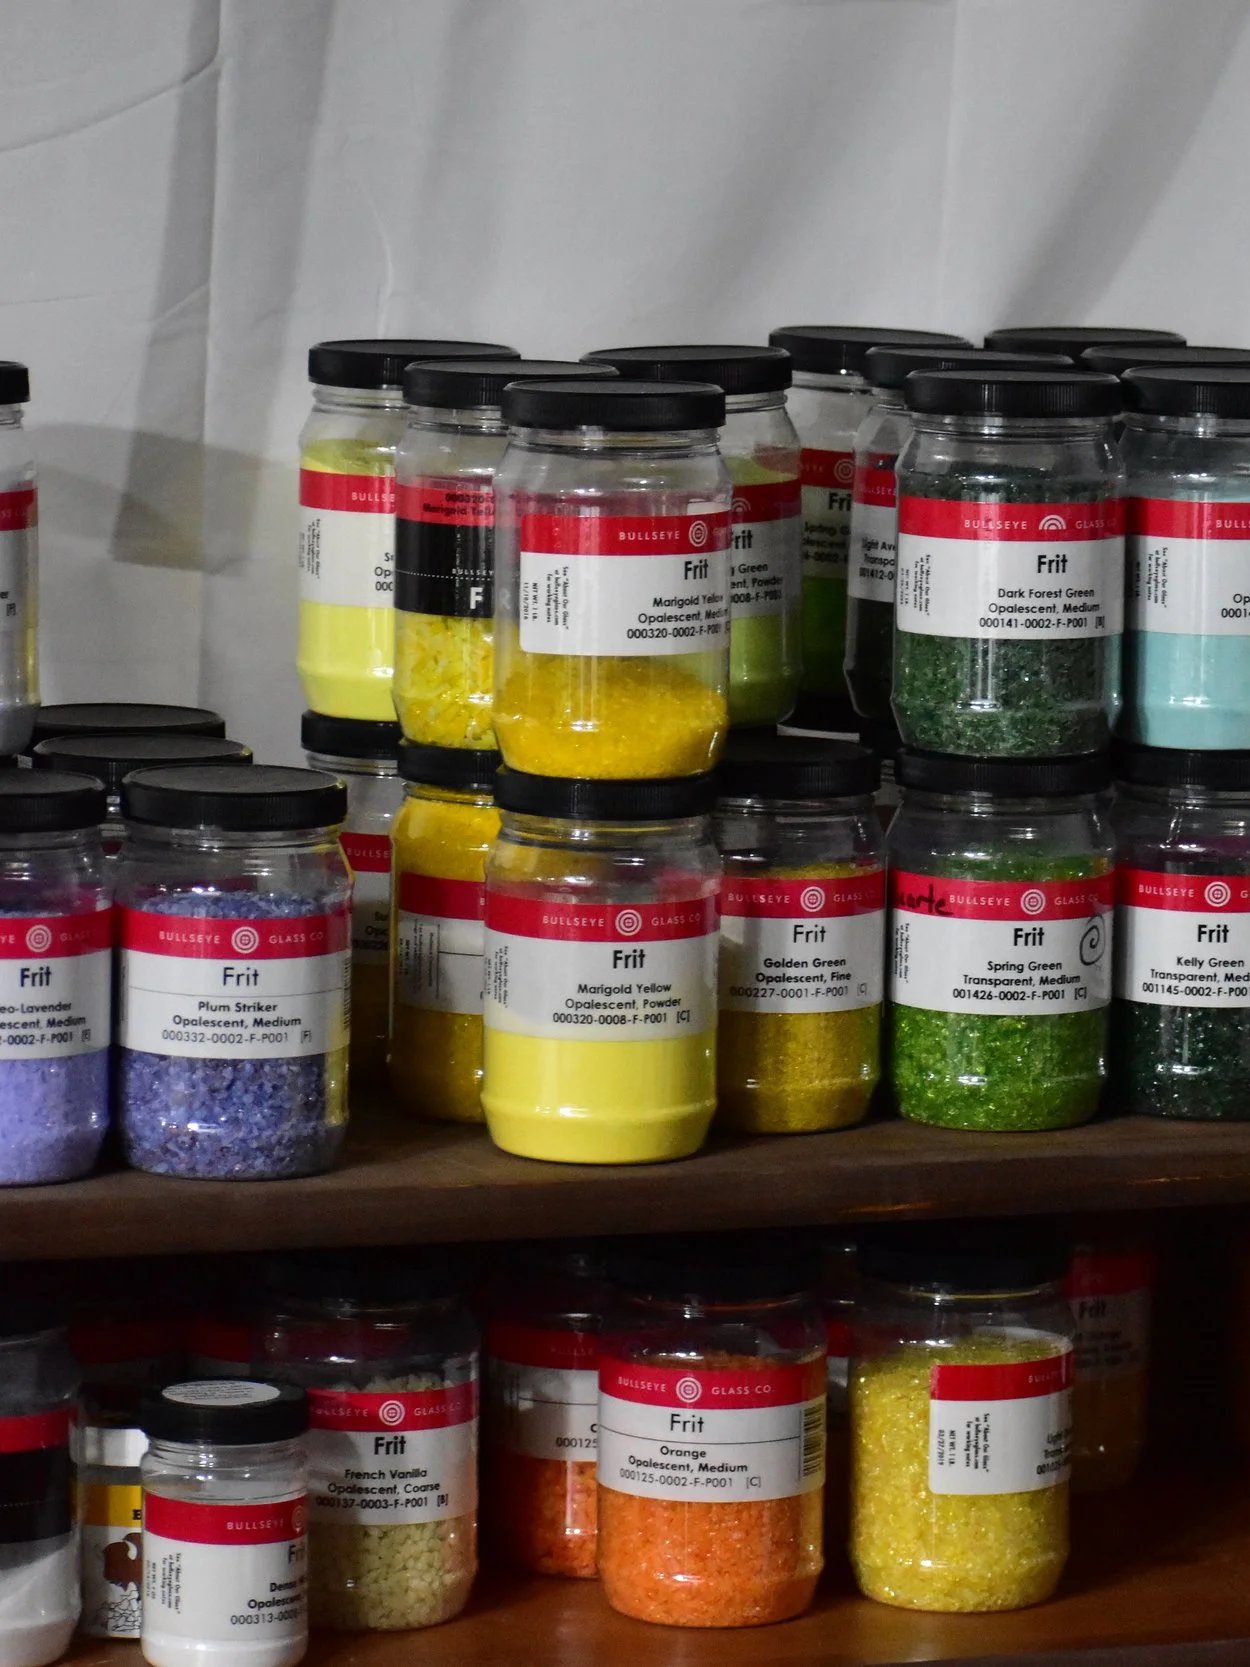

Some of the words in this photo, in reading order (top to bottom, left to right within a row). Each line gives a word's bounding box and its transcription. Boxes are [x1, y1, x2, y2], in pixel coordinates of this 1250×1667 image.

[352, 492, 395, 502] BULLSE
[964, 519, 1027, 530] BULLSEYE
[619, 531, 680, 541] BULLSEYE
[684, 559, 708, 580] Frit
[738, 563, 768, 574] Green
[1037, 554, 1068, 574] Frit
[452, 568, 493, 576] BULLSEY
[998, 588, 1024, 598] Dark
[1029, 588, 1063, 598] Forest
[1066, 588, 1094, 598] Green
[653, 594, 699, 608] Marigold
[988, 603, 1059, 614] Opalescent,
[1063, 603, 1100, 614] Medium
[638, 612, 702, 625] Opalescent,
[979, 618, 1087, 629] 000141-0002-F-P001
[1139, 884, 1195, 898] BULLSEYE
[950, 894, 1010, 907] BULLSEYE
[1054, 894, 1085, 906] GLASS
[542, 916, 605, 927] BULLSEYE
[651, 915, 685, 926] GLASS
[159, 931, 220, 944] BULLSEYE
[268, 931, 306, 944] GLASS
[310, 931, 324, 941] CO
[793, 924, 826, 943] Frit
[1013, 926, 1044, 947] Frit
[1197, 924, 1229, 943] Frit
[613, 949, 645, 969] Frit
[764, 958, 808, 968] Golden
[812, 958, 846, 968] Green
[1176, 956, 1204, 969] Kelly
[1208, 957, 1245, 968] Green
[987, 961, 1025, 974] Spring
[1028, 961, 1062, 971] Green
[19, 966, 52, 987] Frit
[222, 967, 259, 986] Frit
[756, 972, 827, 985] Opalescent,
[831, 972, 852, 981] Fine
[963, 974, 1036, 987] Transparent,
[1039, 974, 1081, 986] Medium
[1150, 969, 1220, 983] Transparent,
[578, 984, 632, 996] Marigold
[636, 983, 672, 994] Yellow
[952, 989, 1065, 1001] 001426-0002-F-P001
[1074, 987, 1087, 1000] [C]
[198, 1001, 230, 1012] Plum
[235, 1002, 278, 1012] Striker
[565, 999, 639, 1010] Opalescent,
[643, 997, 681, 1009] Powder
[0, 1019, 42, 1030] escent,
[46, 1016, 86, 1029] Medium
[172, 1015, 249, 1030] Opalescent,
[252, 1016, 301, 1027] Medium
[552, 1012, 667, 1024] 000320-0008-F-P001
[677, 1010, 690, 1024] [C]
[162, 1029, 288, 1044] 000332-0002-F-P001
[618, 1376, 666, 1392] BULLSEYE
[711, 1386, 750, 1395] GLASS
[670, 1413, 704, 1433] Frit
[374, 1436, 406, 1455] Frit
[555, 1437, 598, 1448] 000125
[660, 1446, 707, 1460] Orange
[628, 1455, 694, 1473] Opalescent,
[698, 1462, 748, 1473] Medium
[344, 1469, 386, 1480] French
[390, 1469, 427, 1479] Vanilla
[619, 1467, 733, 1488] 000125-0002-F-P001
[327, 1483, 400, 1495] Opalescent,
[404, 1483, 440, 1493] Coarse
